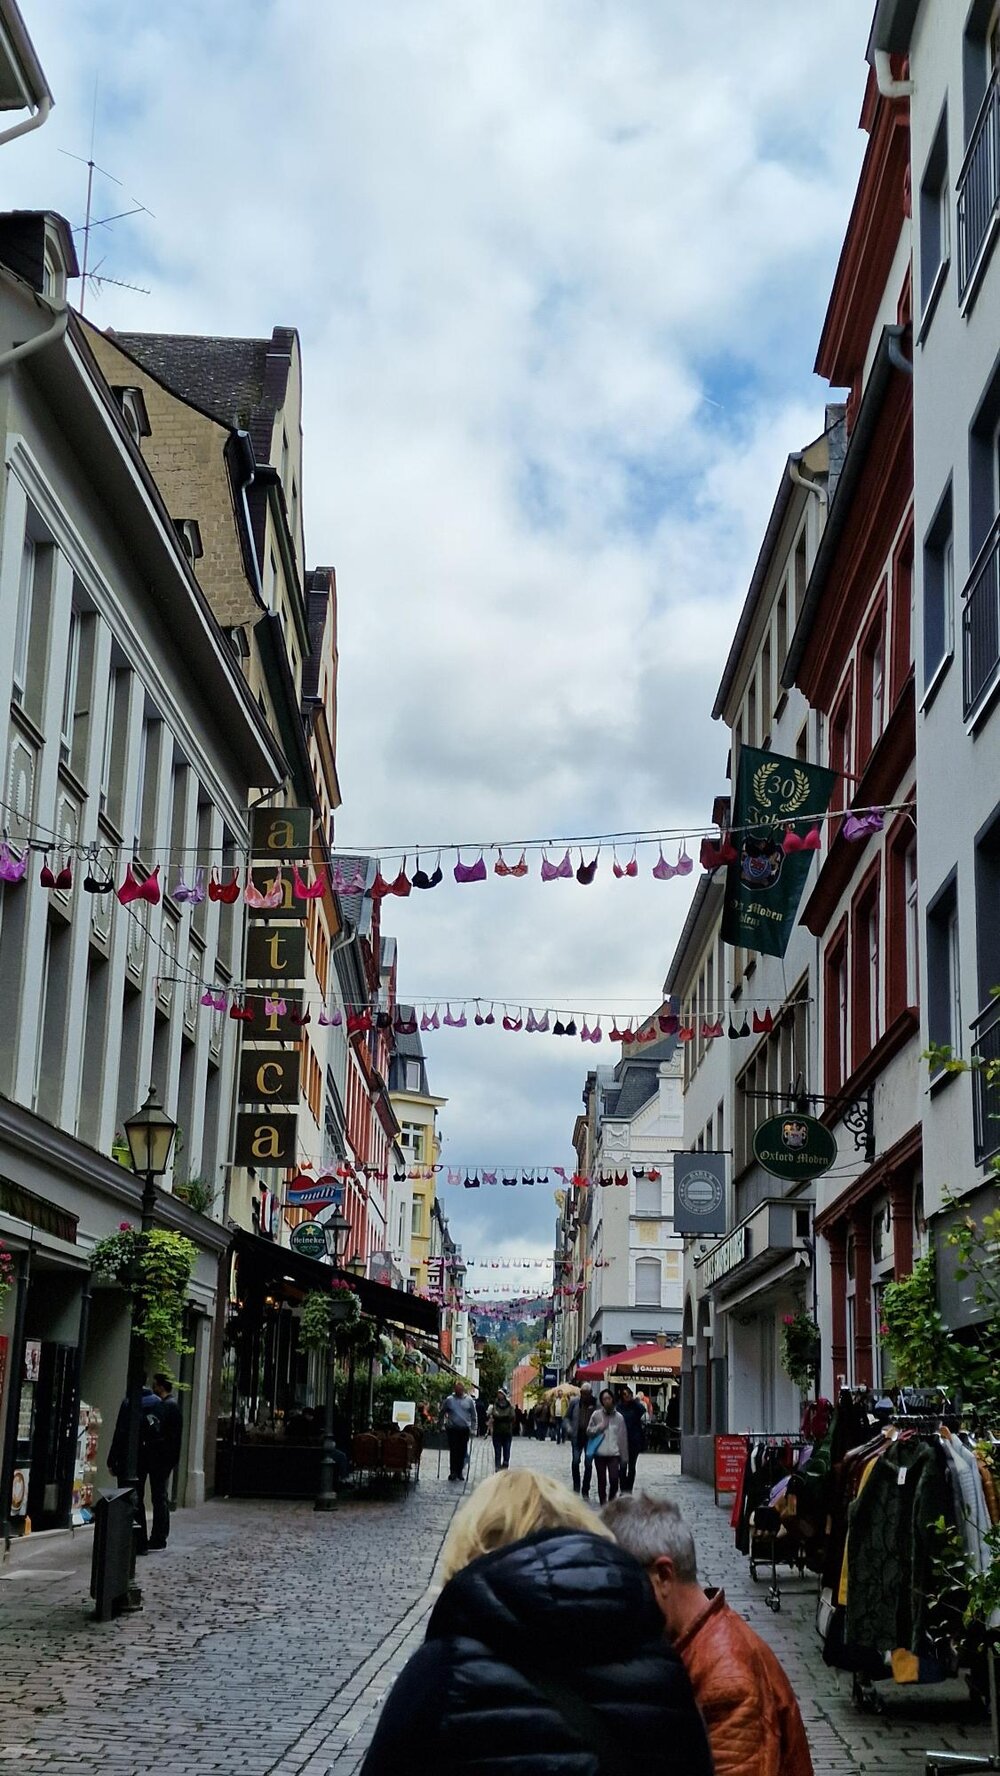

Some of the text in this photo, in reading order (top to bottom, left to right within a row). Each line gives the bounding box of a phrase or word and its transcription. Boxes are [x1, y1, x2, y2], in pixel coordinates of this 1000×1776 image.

[767, 774, 796, 800] 30
[746, 902, 784, 922] Moden
[759, 1150, 829, 1166] Oxford Moden
[640, 1365, 673, 1374] GALESTRO
